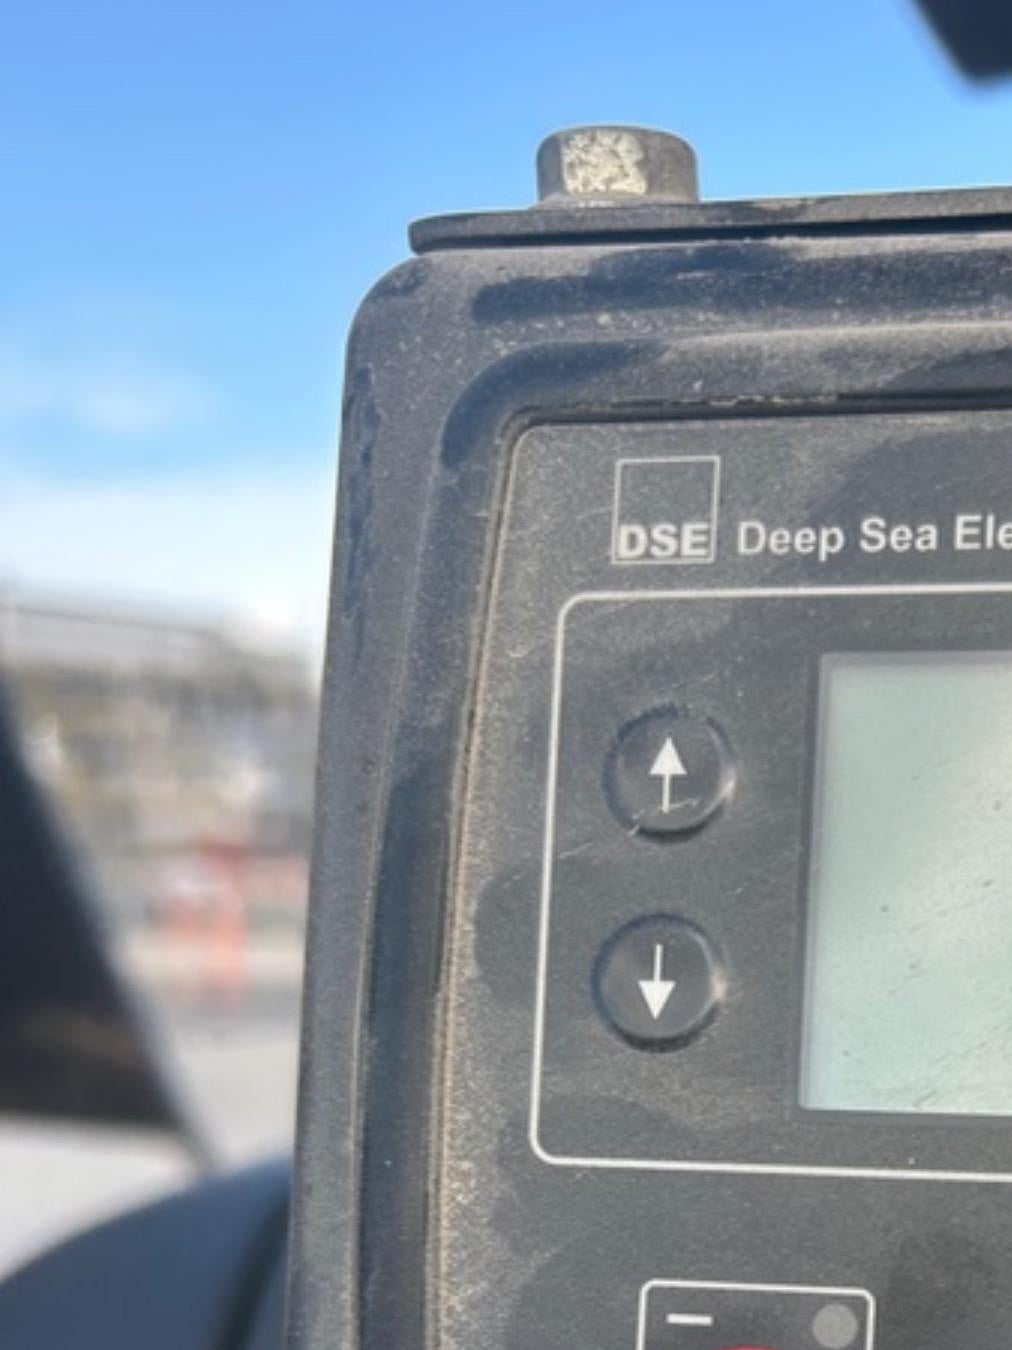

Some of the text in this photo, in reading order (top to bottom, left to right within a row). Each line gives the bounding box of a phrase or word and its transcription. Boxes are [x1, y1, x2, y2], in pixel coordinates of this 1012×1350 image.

[617, 523, 709, 558] DSE
[737, 519, 845, 561] Deep
[859, 515, 938, 552] Sea
